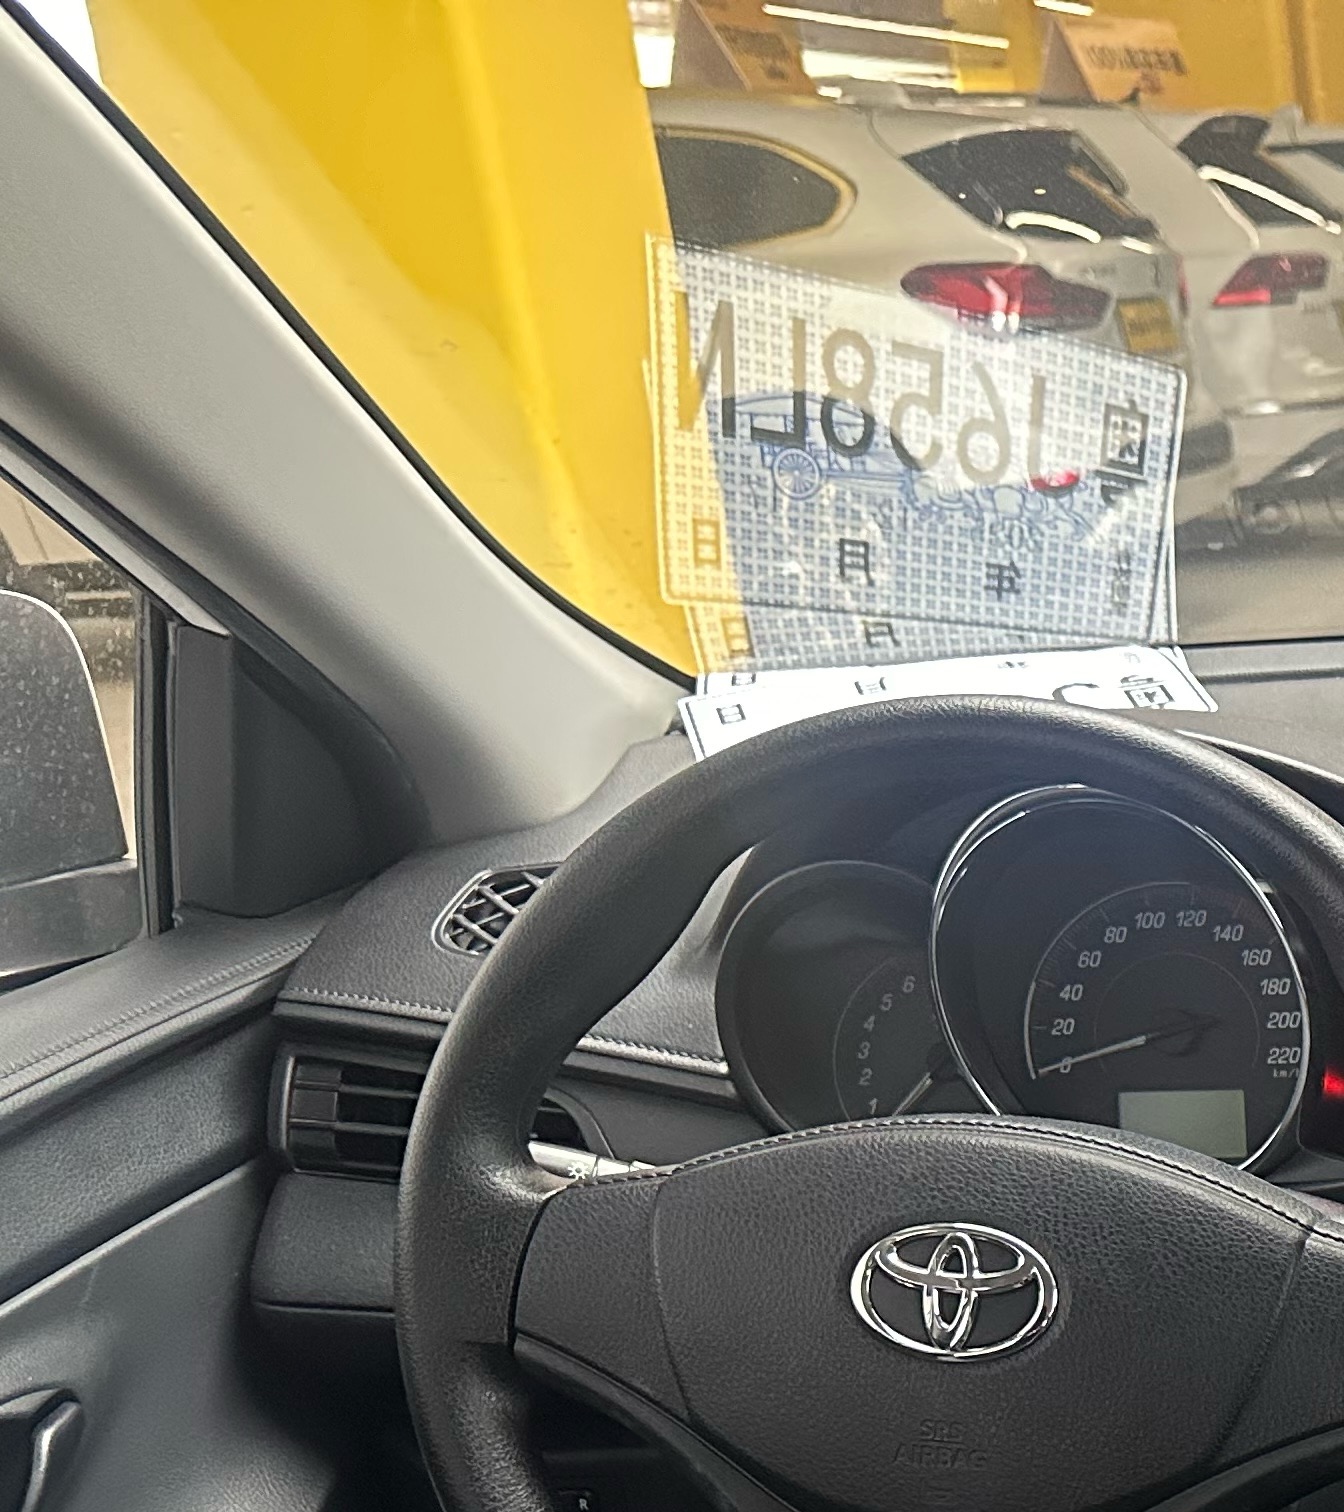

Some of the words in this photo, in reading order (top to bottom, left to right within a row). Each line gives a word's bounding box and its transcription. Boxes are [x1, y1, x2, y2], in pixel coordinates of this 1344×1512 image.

[1134, 911, 1166, 930] 100
[1175, 909, 1207, 928] 120
[1103, 926, 1128, 944] 80
[1212, 924, 1245, 943] 140
[1077, 950, 1102, 969] 60
[1241, 949, 1272, 967] 160
[902, 975, 917, 994] 6
[1059, 983, 1084, 1001] 40
[1260, 977, 1291, 996] 180
[879, 993, 894, 1012] 5
[863, 1015, 876, 1033] 4
[1051, 1017, 1075, 1036] 20
[1266, 1011, 1301, 1030] 200
[857, 1041, 871, 1060] 3
[1266, 1047, 1301, 1065] 220
[857, 1067, 873, 1087] 2
[868, 1097, 878, 1115] 1
